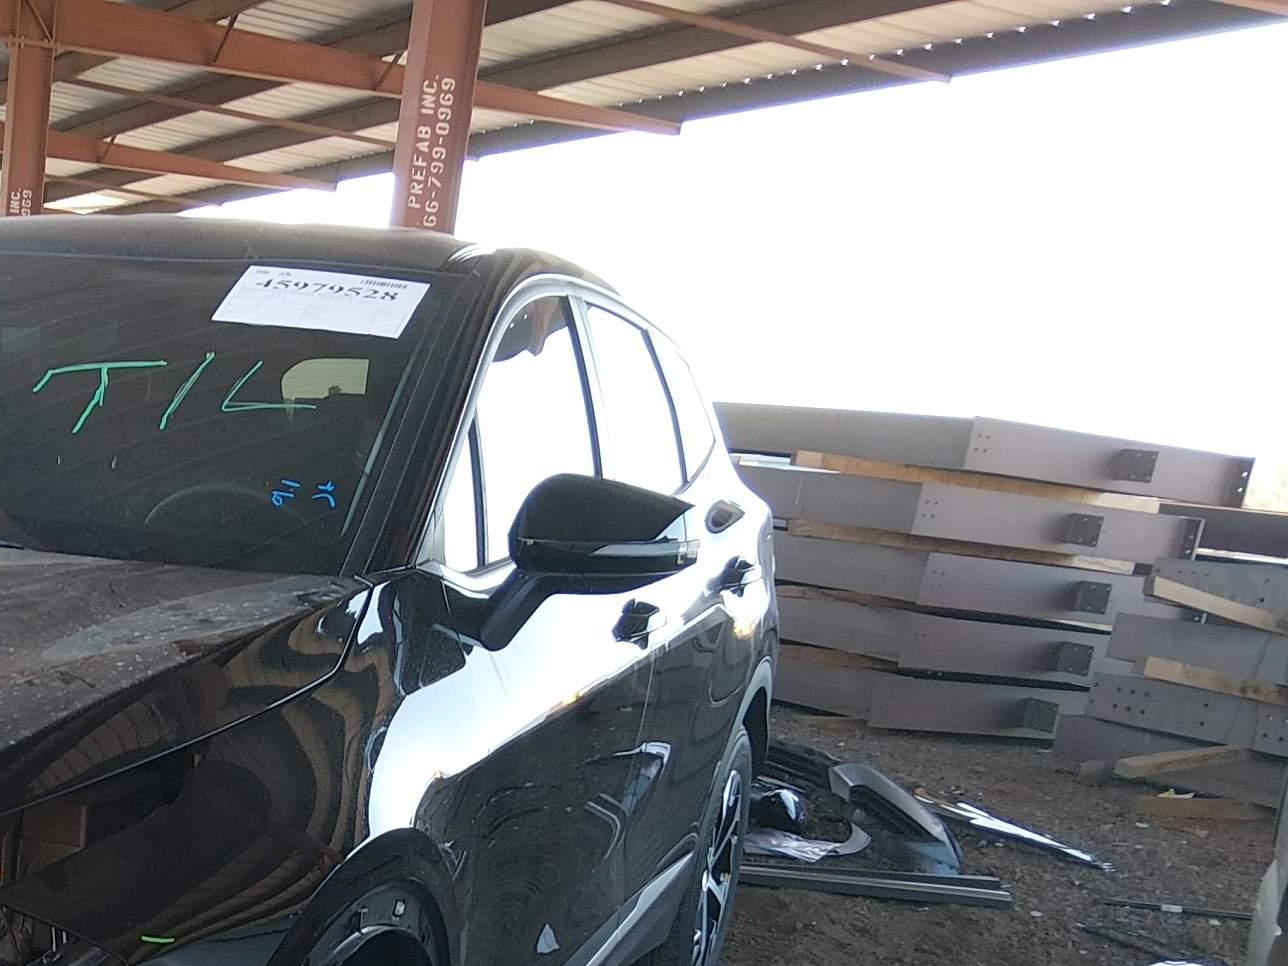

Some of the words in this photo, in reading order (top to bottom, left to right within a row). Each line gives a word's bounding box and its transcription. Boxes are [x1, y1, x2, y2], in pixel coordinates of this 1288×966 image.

[408, 125, 432, 209] PREFAB
[421, 74, 439, 115] INC.
[256, 278, 399, 301] 45979528
